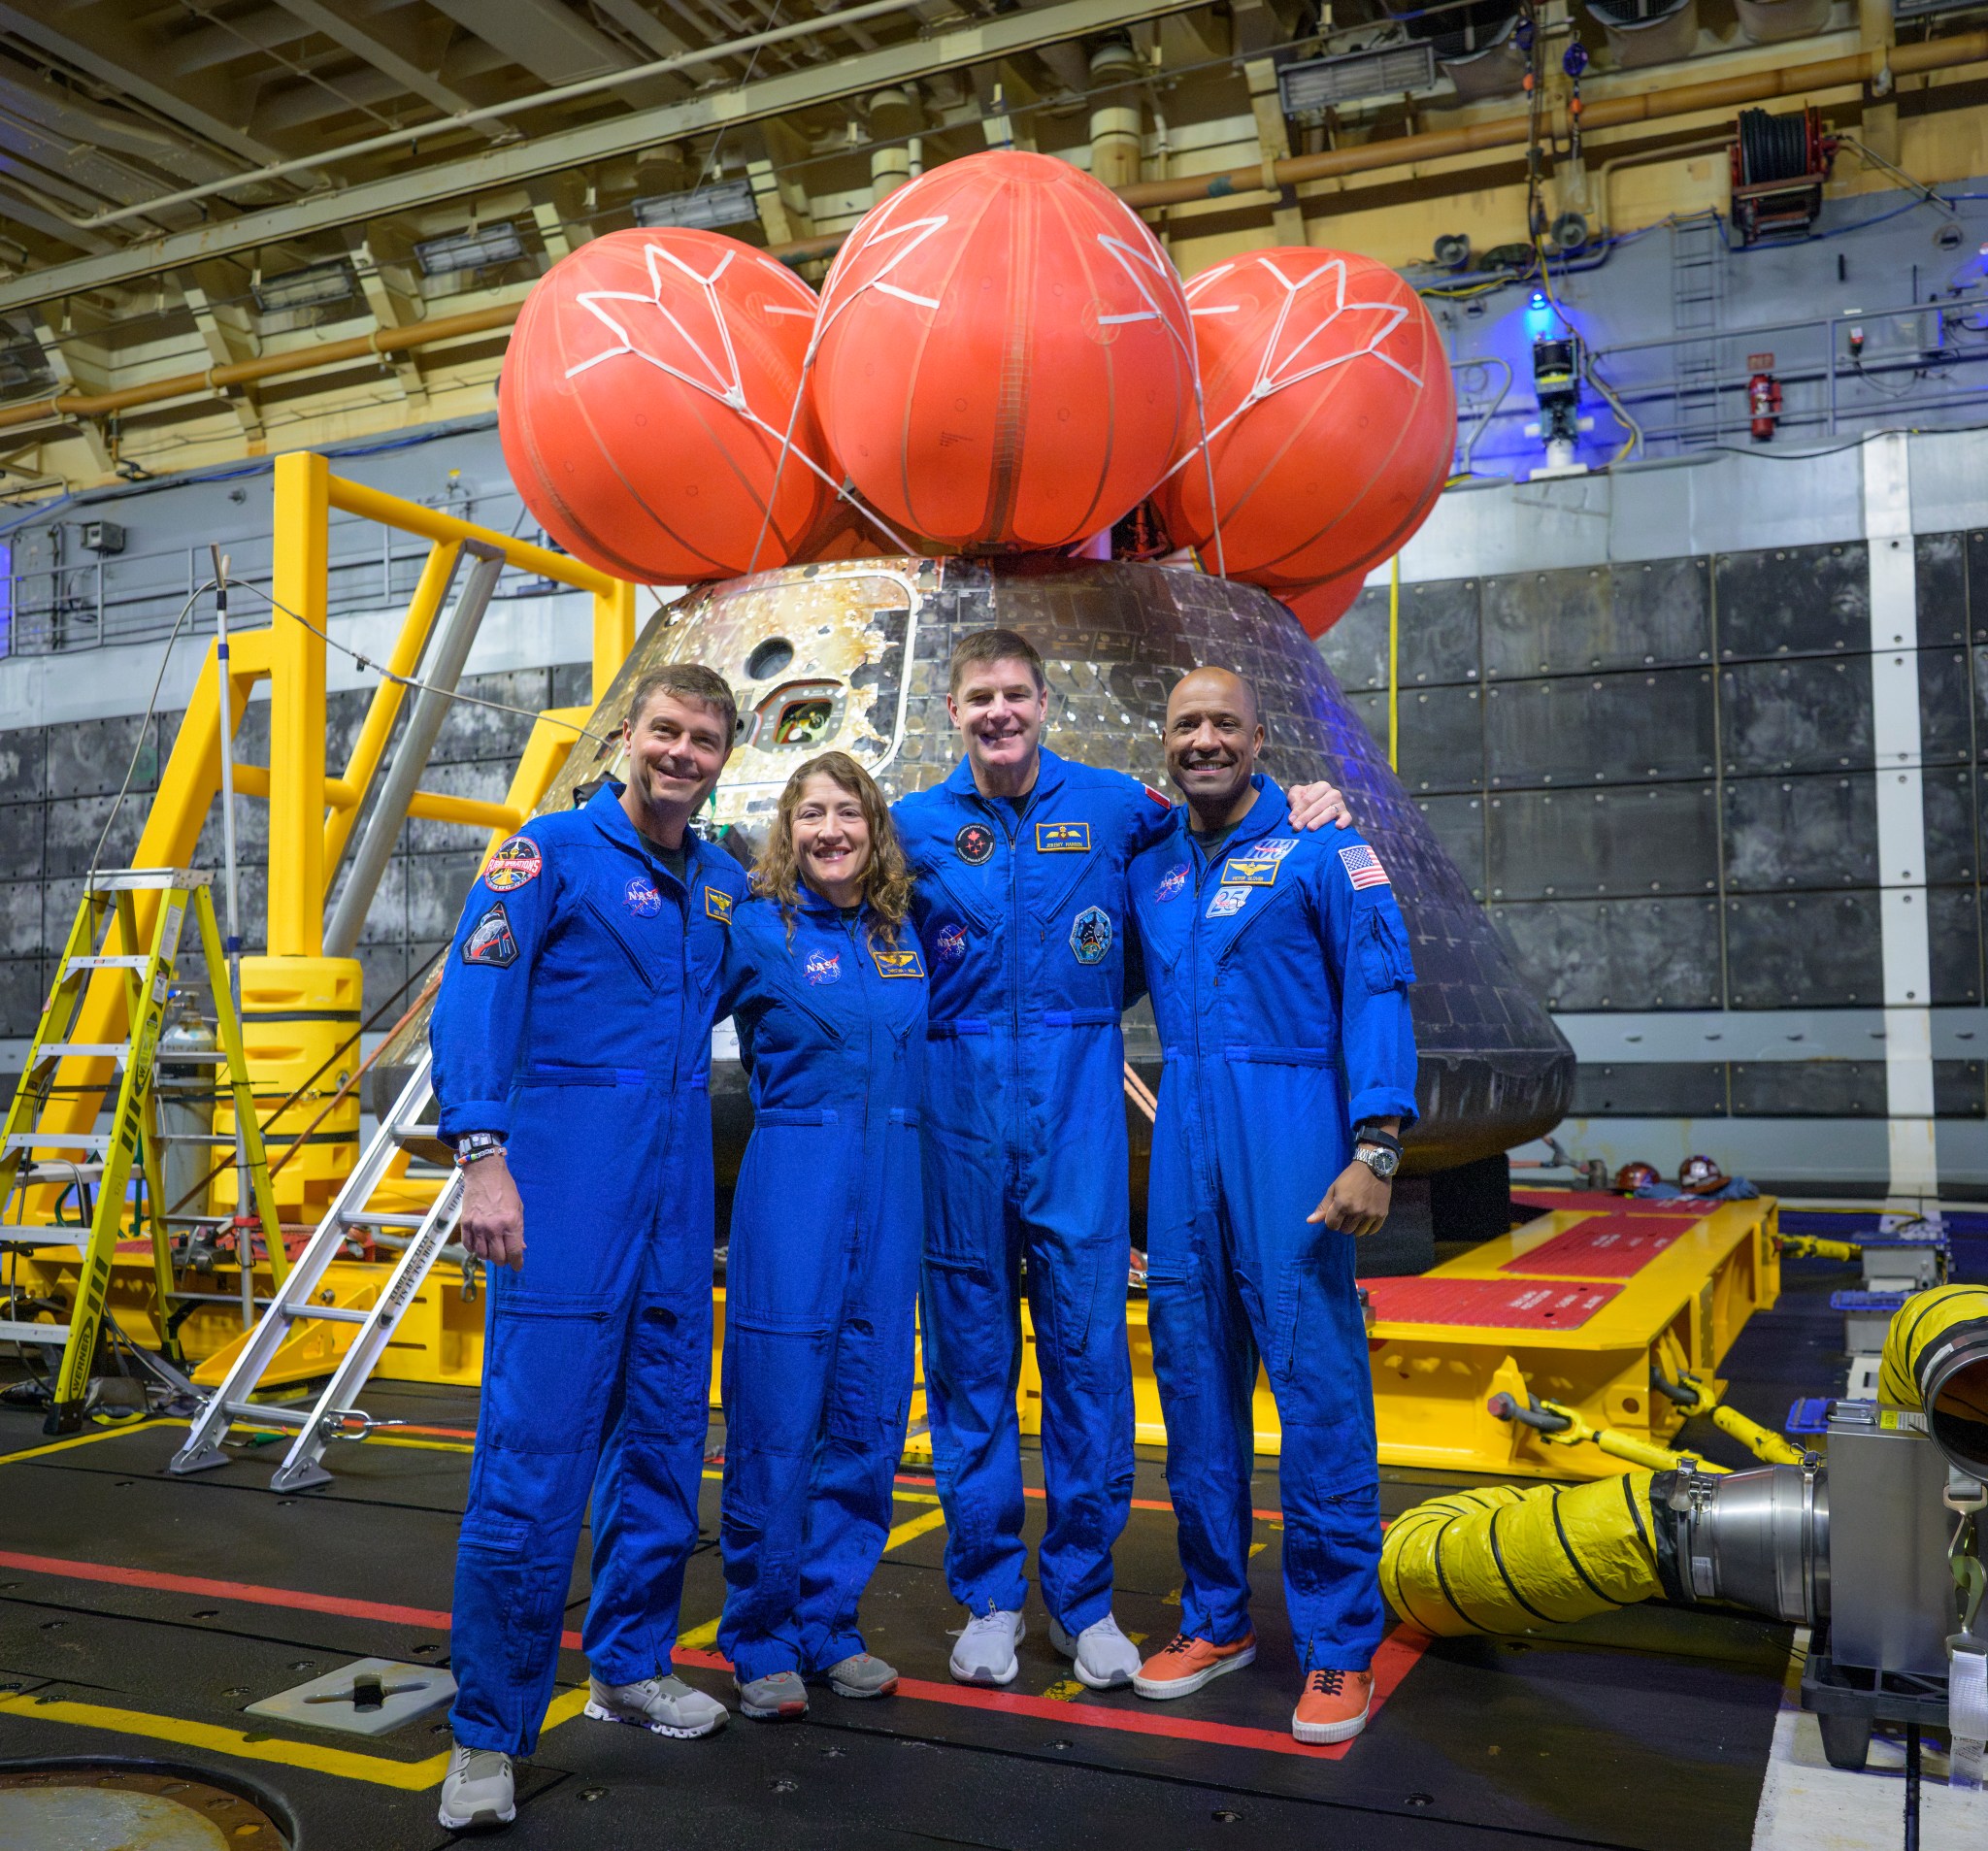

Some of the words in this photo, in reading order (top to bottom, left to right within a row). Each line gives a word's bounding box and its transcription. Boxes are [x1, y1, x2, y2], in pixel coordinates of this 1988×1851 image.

[505, 859, 542, 874] OPERATIONS
[628, 891, 661, 904] NASA
[1210, 891, 1244, 913] 25
[937, 937, 965, 948] NASA
[807, 960, 841, 975] NASA
[423, 1240, 436, 1258] FOR
[412, 1257, 426, 1277] USE
[405, 1275, 415, 1291] AT
[393, 1290, 409, 1306] SEA
[73, 1334, 90, 1392] WERNER
